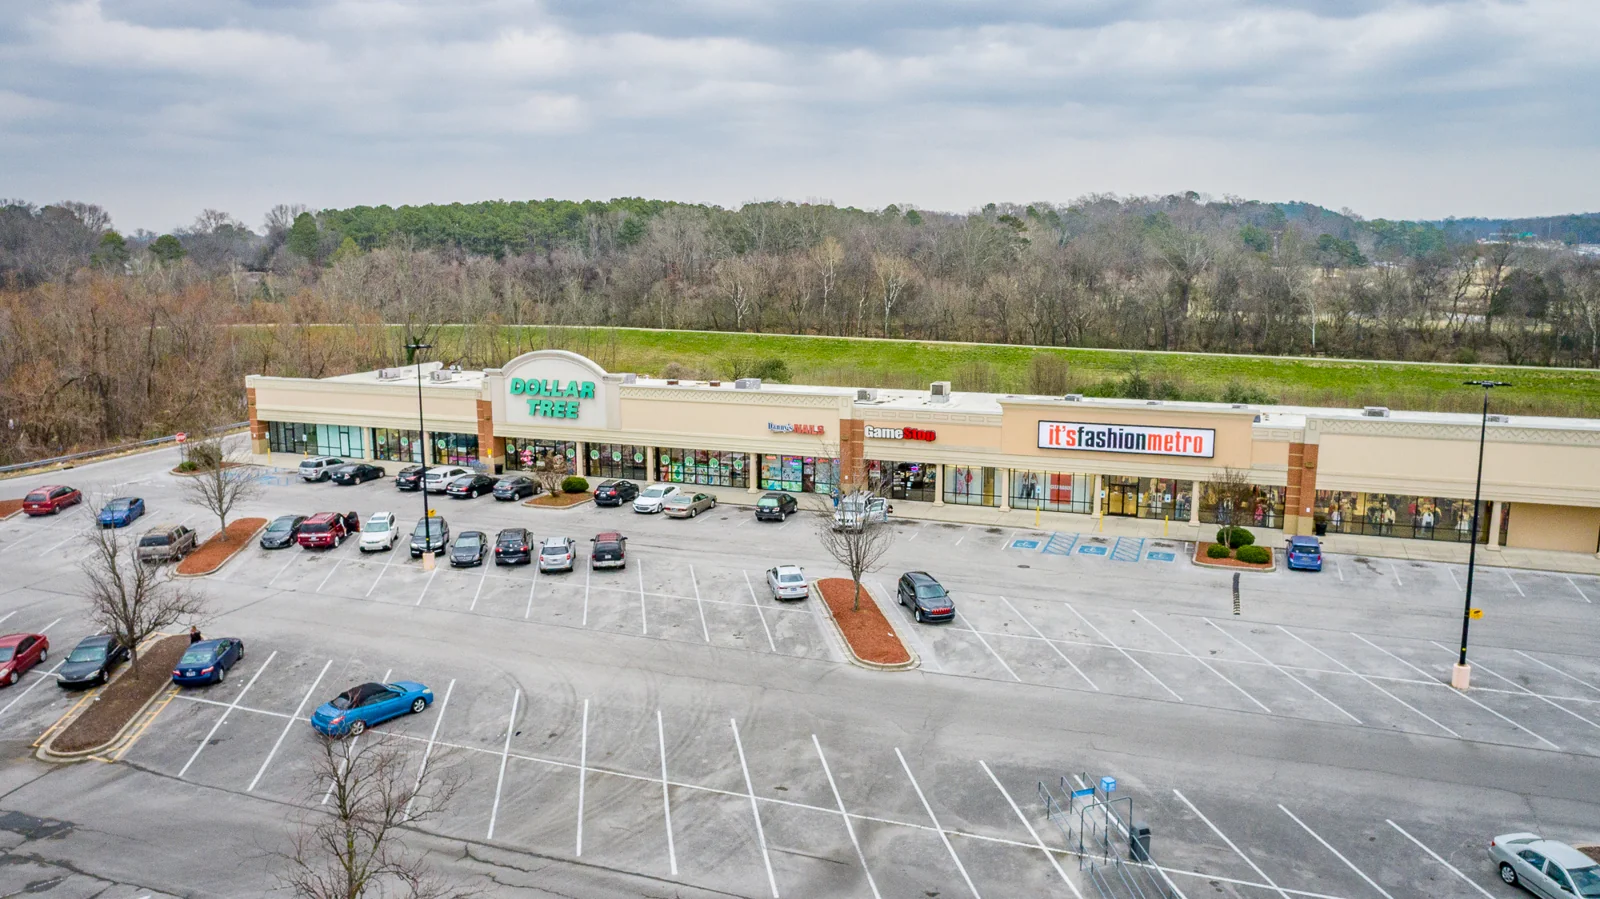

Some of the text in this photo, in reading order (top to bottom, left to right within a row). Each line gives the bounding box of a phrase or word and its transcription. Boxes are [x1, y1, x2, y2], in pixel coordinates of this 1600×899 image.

[510, 377, 595, 398] DOLLAR
[527, 398, 580, 418] TREE
[793, 423, 825, 435] NAILS
[864, 425, 936, 442] GameStop
